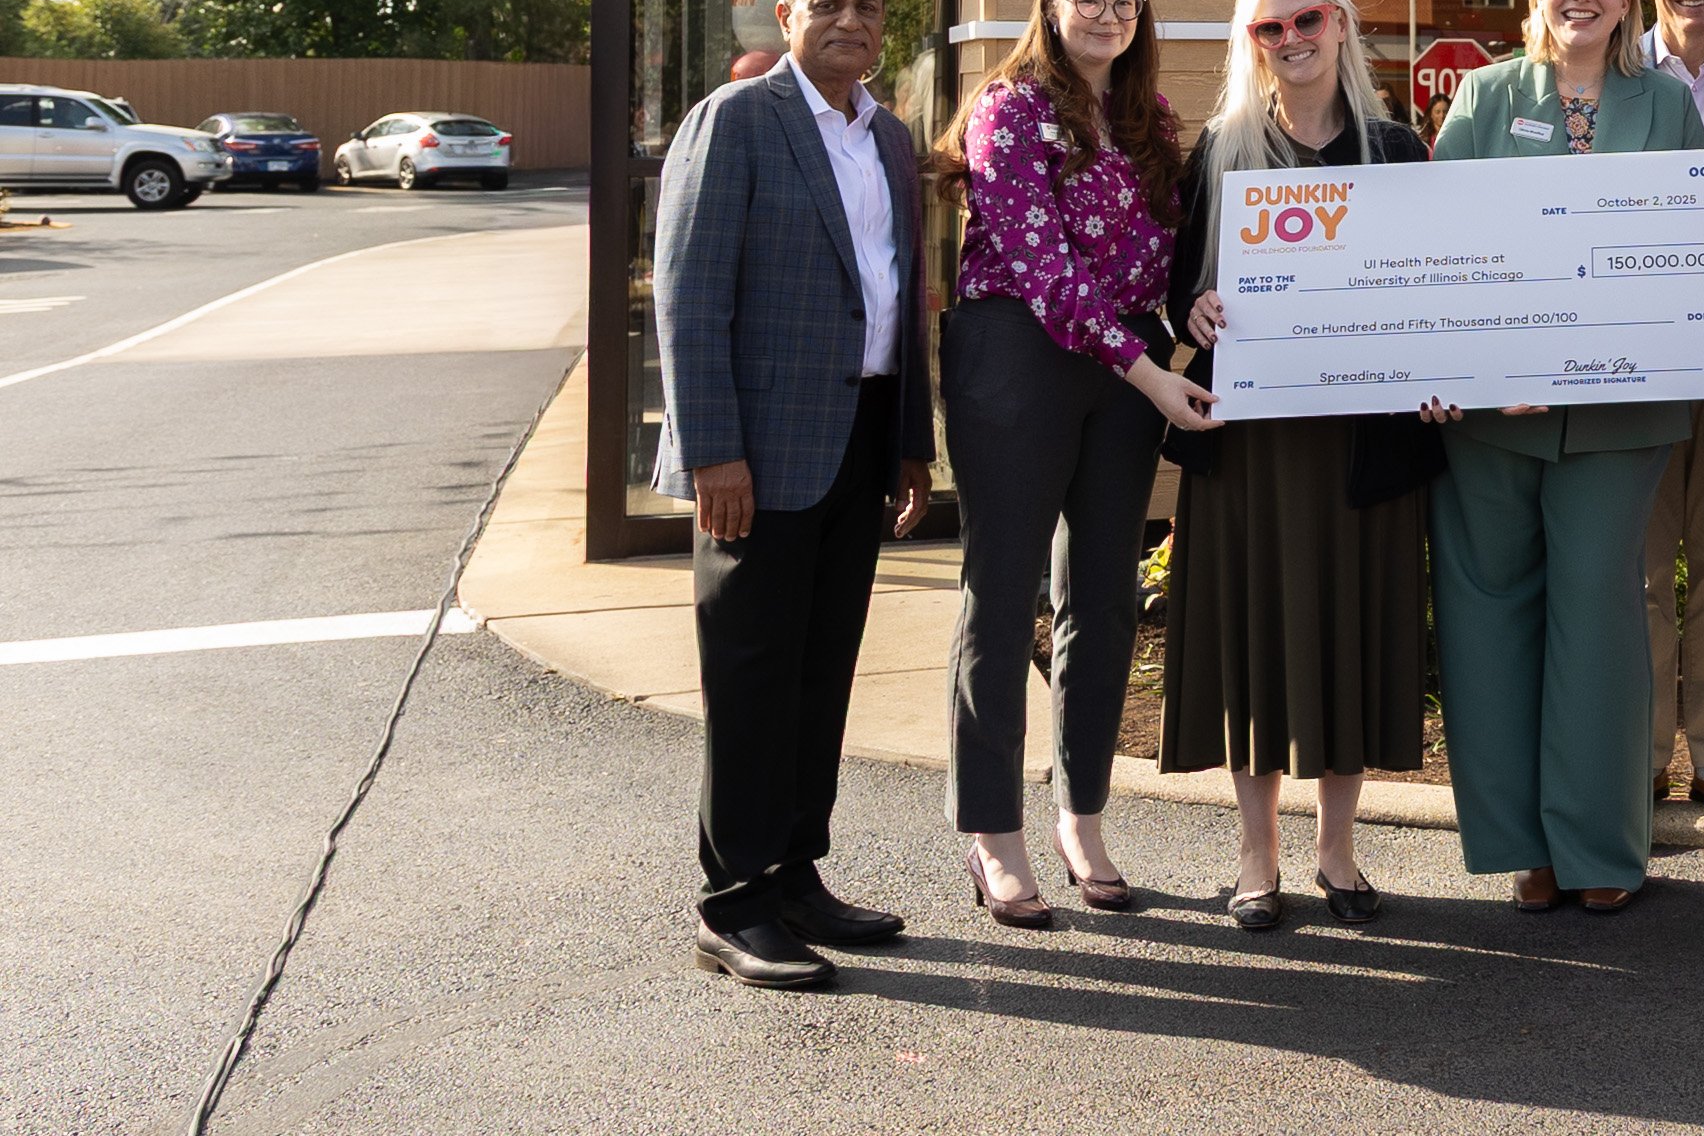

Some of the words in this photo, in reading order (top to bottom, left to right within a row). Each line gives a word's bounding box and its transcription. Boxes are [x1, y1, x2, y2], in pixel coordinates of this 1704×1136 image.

[1245, 182, 1354, 206] DUNKIN'
[1597, 197, 1650, 208] October
[1652, 196, 1663, 206] 2,
[1666, 194, 1697, 205] 2025
[1542, 207, 1567, 215] DATE
[1240, 205, 1348, 244] JOY
[1251, 246, 1297, 255] CHILDHOOD
[1363, 259, 1376, 269] UI
[1380, 257, 1421, 269] Health
[1425, 254, 1488, 266] Pediatrics
[1491, 254, 1505, 264] at
[1577, 264, 1586, 278] $
[1238, 276, 1257, 285] PAY
[1259, 275, 1273, 284] TO
[1276, 274, 1296, 283] THE
[1348, 274, 1410, 287] University
[1413, 273, 1427, 284] of
[1429, 271, 1468, 283] Illinois
[1471, 270, 1524, 282] Chicago
[1238, 284, 1272, 293] ORDER
[1274, 283, 1289, 292] OF
[1292, 324, 1318, 335] One
[1322, 321, 1377, 334] Hundred
[1380, 320, 1404, 331] and
[1408, 318, 1436, 331] Fifty
[1440, 316, 1501, 329] Thousand
[1504, 313, 1529, 326] and
[1532, 312, 1578, 325] 00/100
[1563, 358, 1612, 372] Dunkin'
[1611, 357, 1638, 374] Joy
[1319, 370, 1385, 385] Spreading
[1388, 369, 1411, 381] Joy
[1552, 377, 1601, 386] AUTHORIZED
[1603, 376, 1646, 384] SIGNATURE
[1233, 380, 1254, 389] FOR
